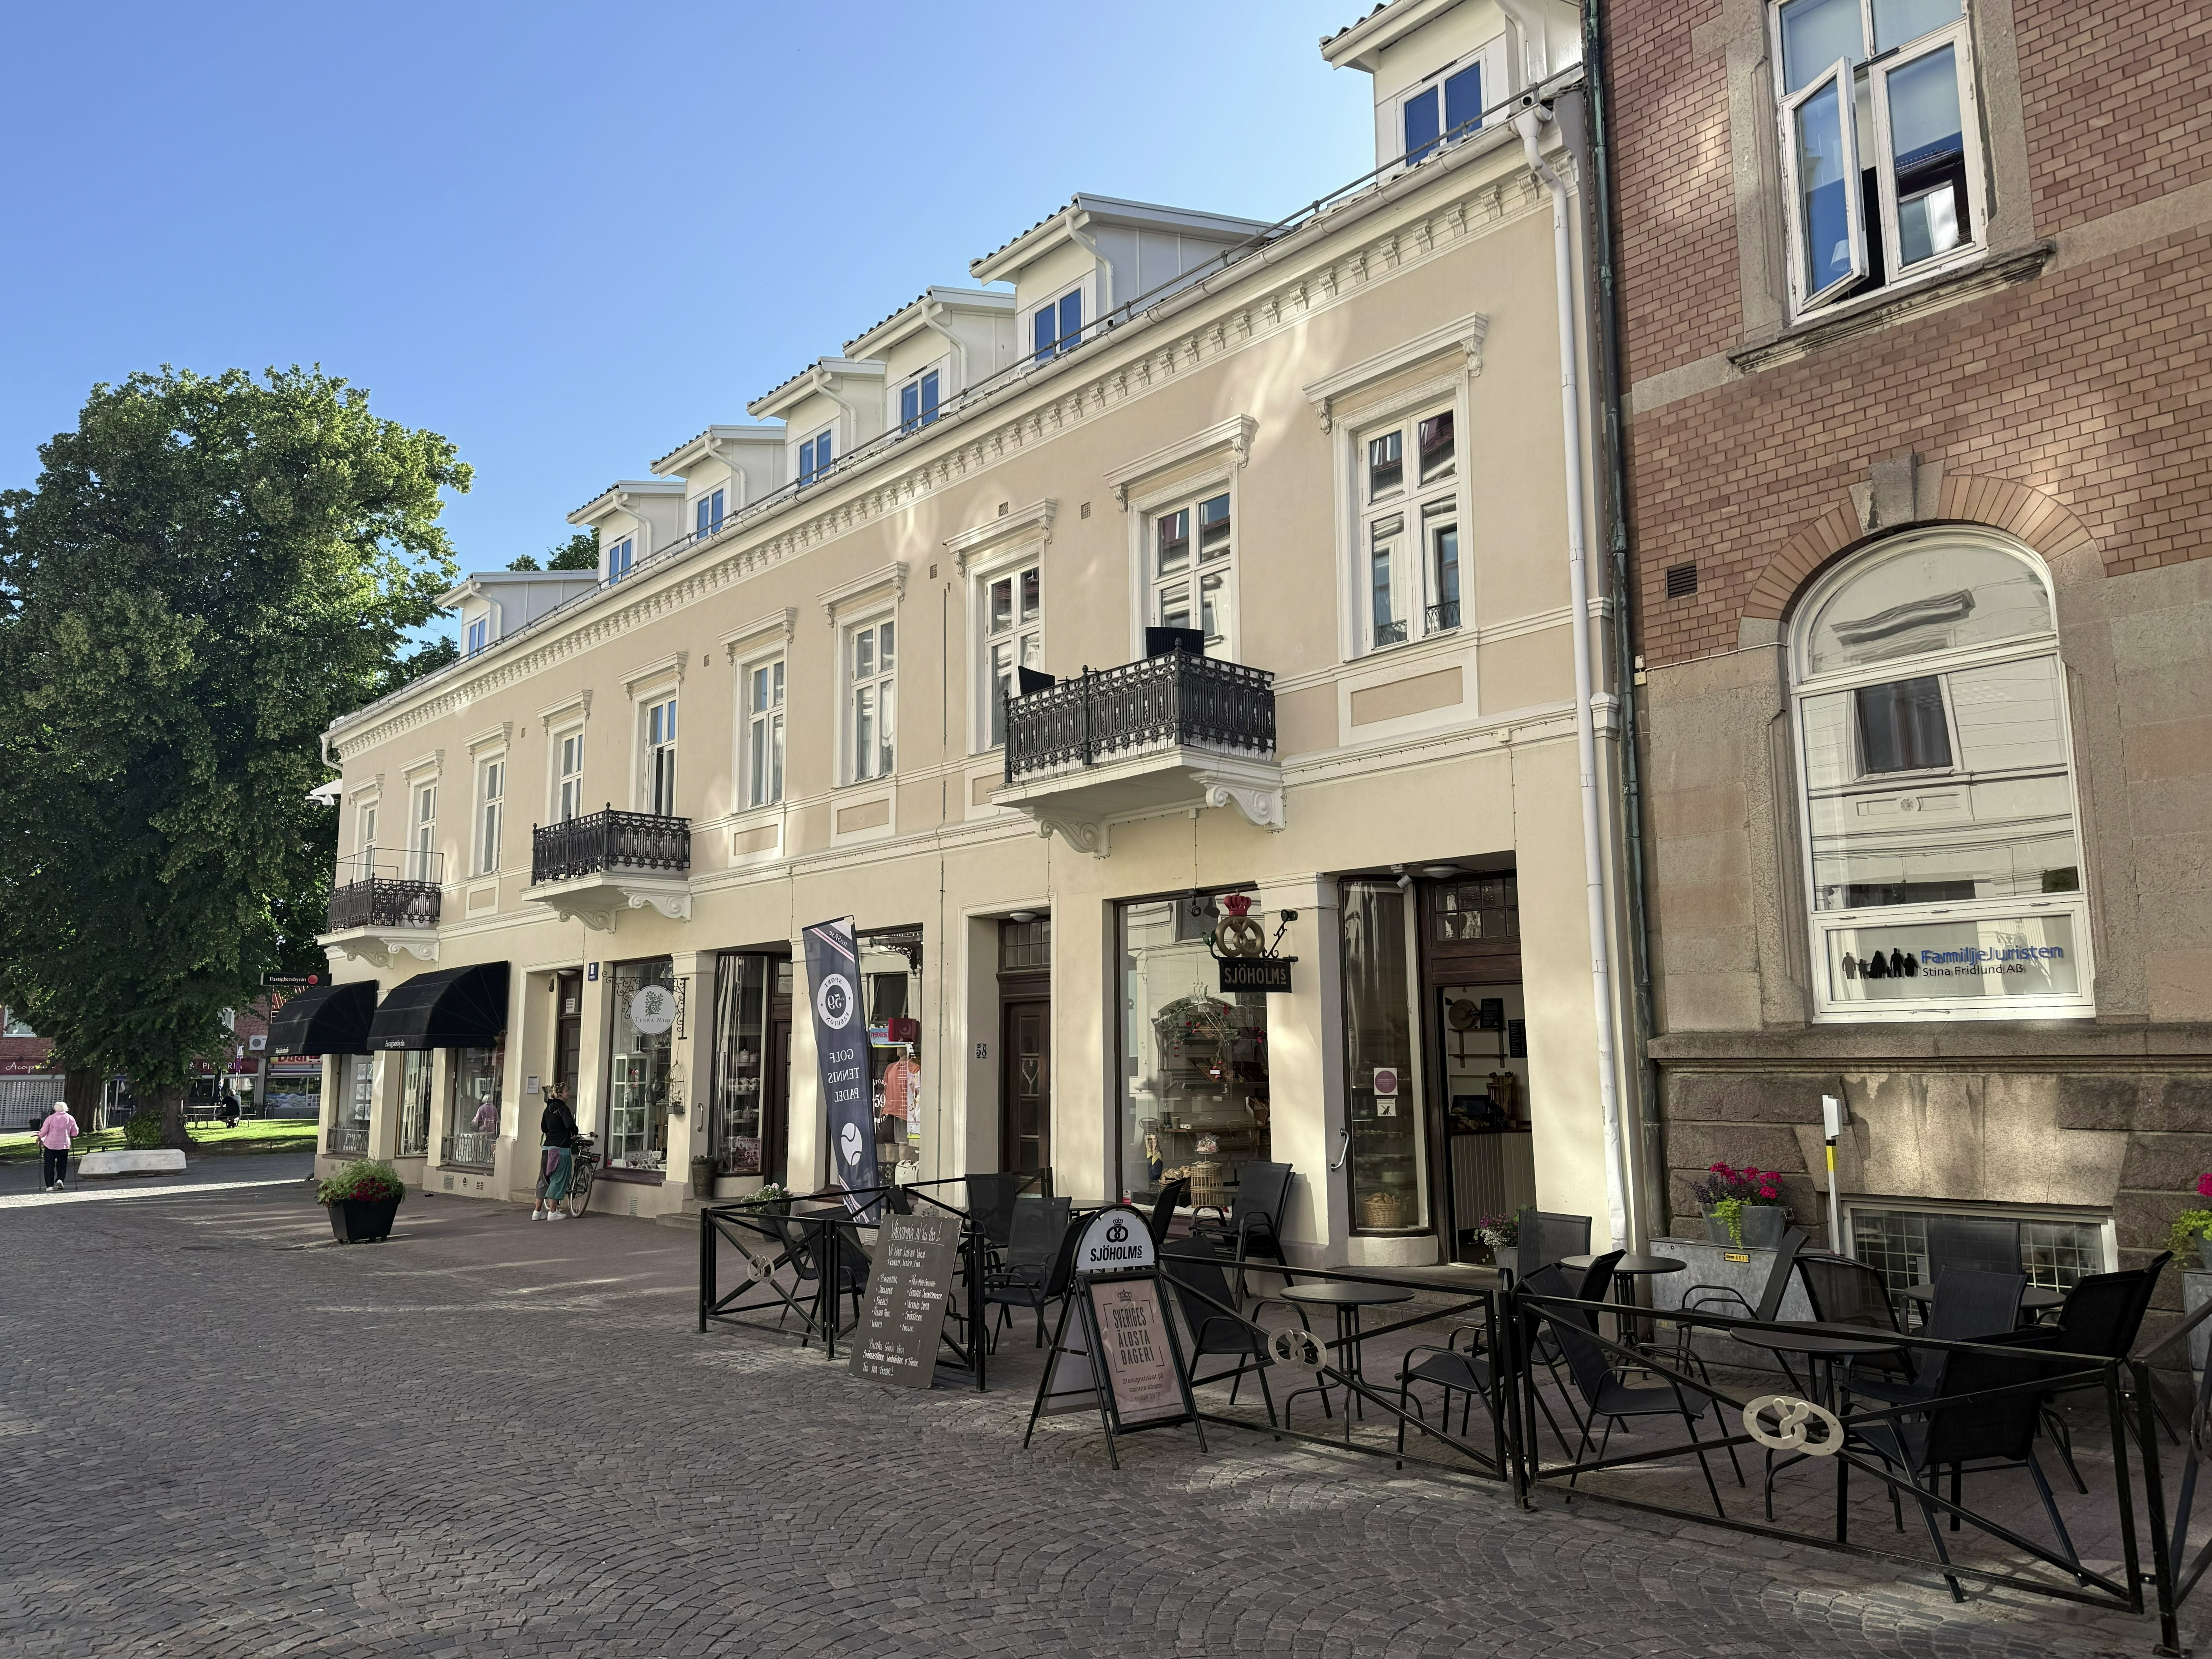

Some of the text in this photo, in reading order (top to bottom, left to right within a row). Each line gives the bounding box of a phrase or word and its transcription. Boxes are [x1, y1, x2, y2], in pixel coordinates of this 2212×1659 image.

[1921, 945, 2063, 966] FamiljeJuristen
[1923, 964, 2023, 977] Stina Fridlund AB
[976, 1046, 987, 1056] 58
[875, 1094, 886, 1108] 59
[1113, 1307, 1146, 1329] SVERIGES
[1117, 1329, 1150, 1348] ÄLDSTA
[1120, 1346, 1154, 1365] BAGERI
